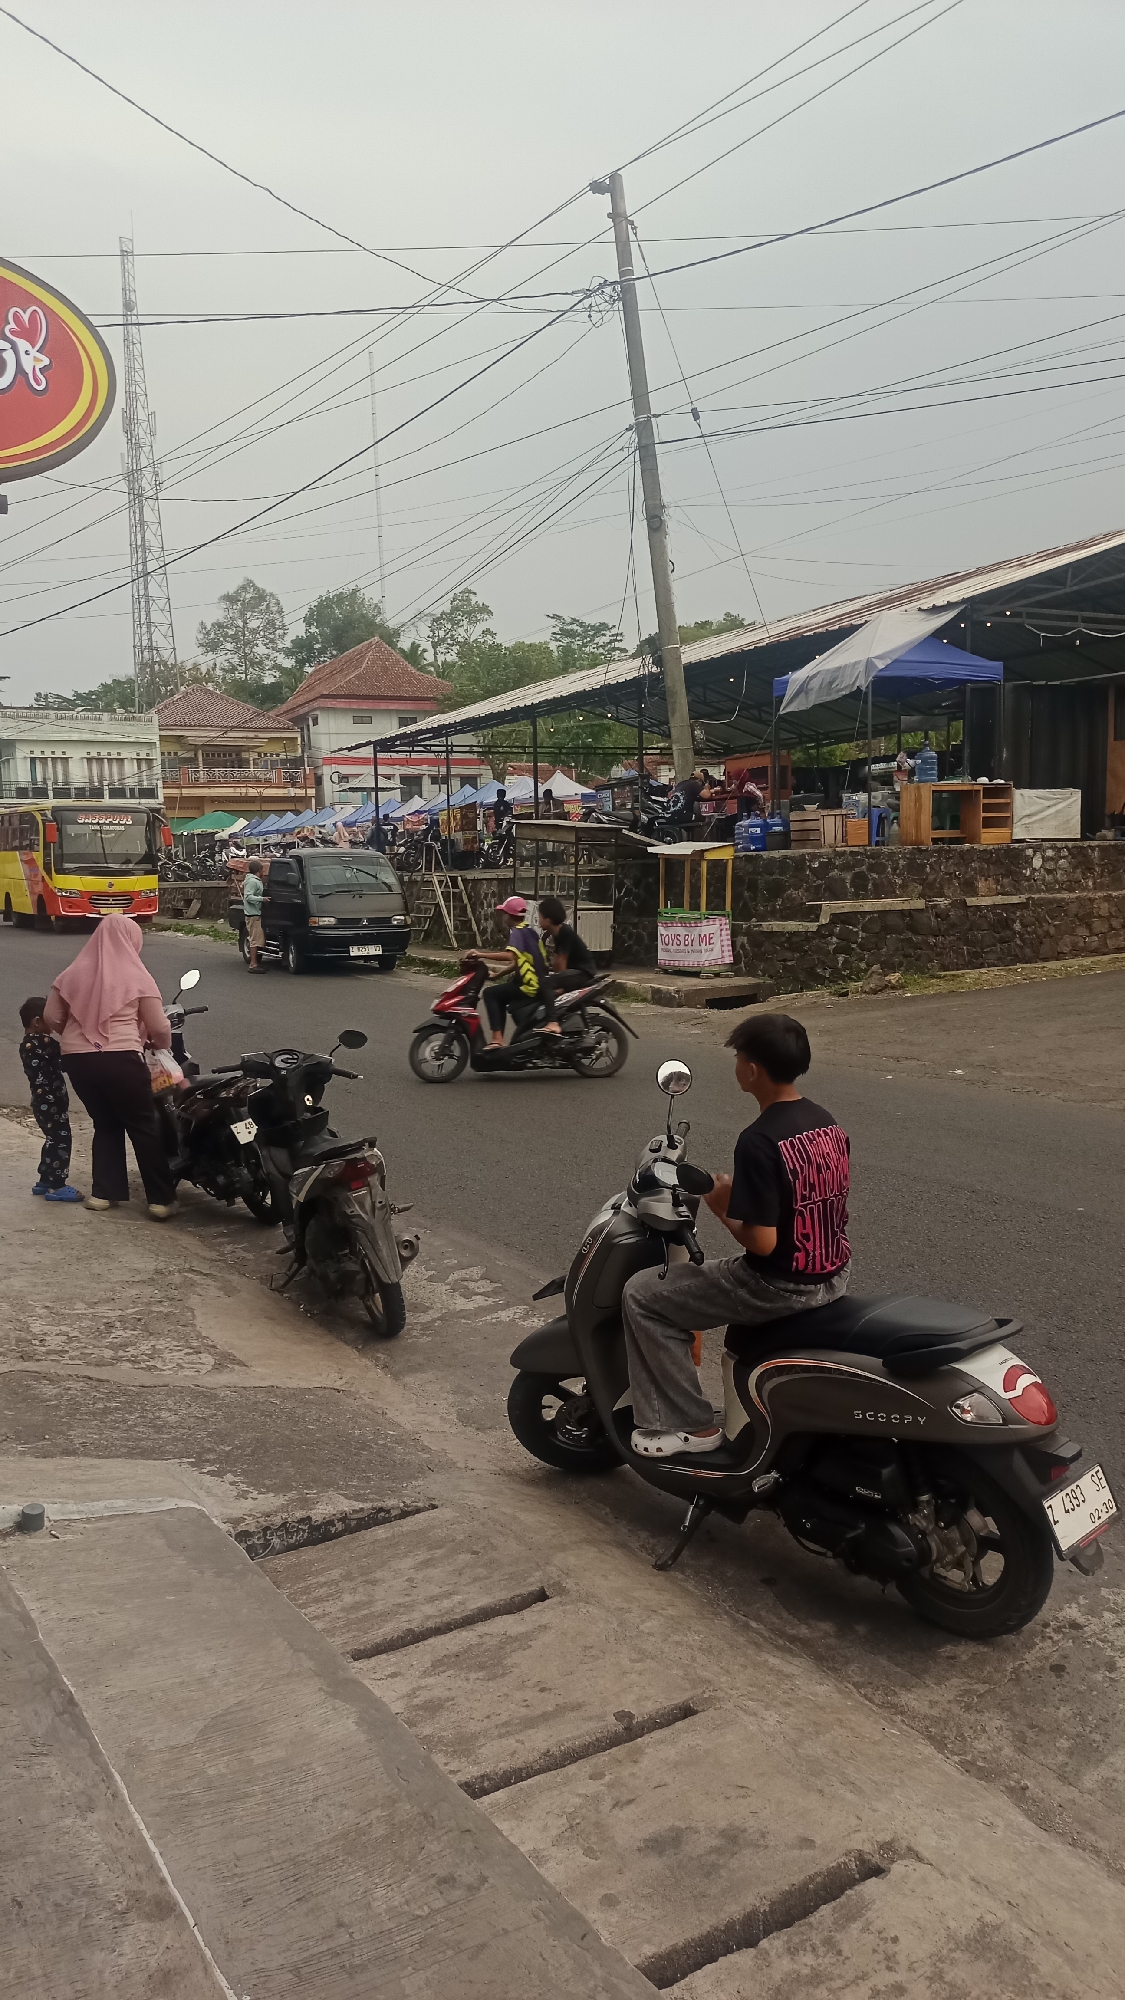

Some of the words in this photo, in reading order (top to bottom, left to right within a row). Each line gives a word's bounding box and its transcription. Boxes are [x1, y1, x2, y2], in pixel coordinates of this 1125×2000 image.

[660, 934, 681, 946] TOYS
[684, 934, 696, 946] BY
[699, 933, 714, 946] ME
[854, 1411, 926, 1425] SCOOPY
[1047, 1504, 1059, 1525] Z
[1062, 1484, 1086, 1514] 4393
[1091, 1469, 1106, 1491] SE
